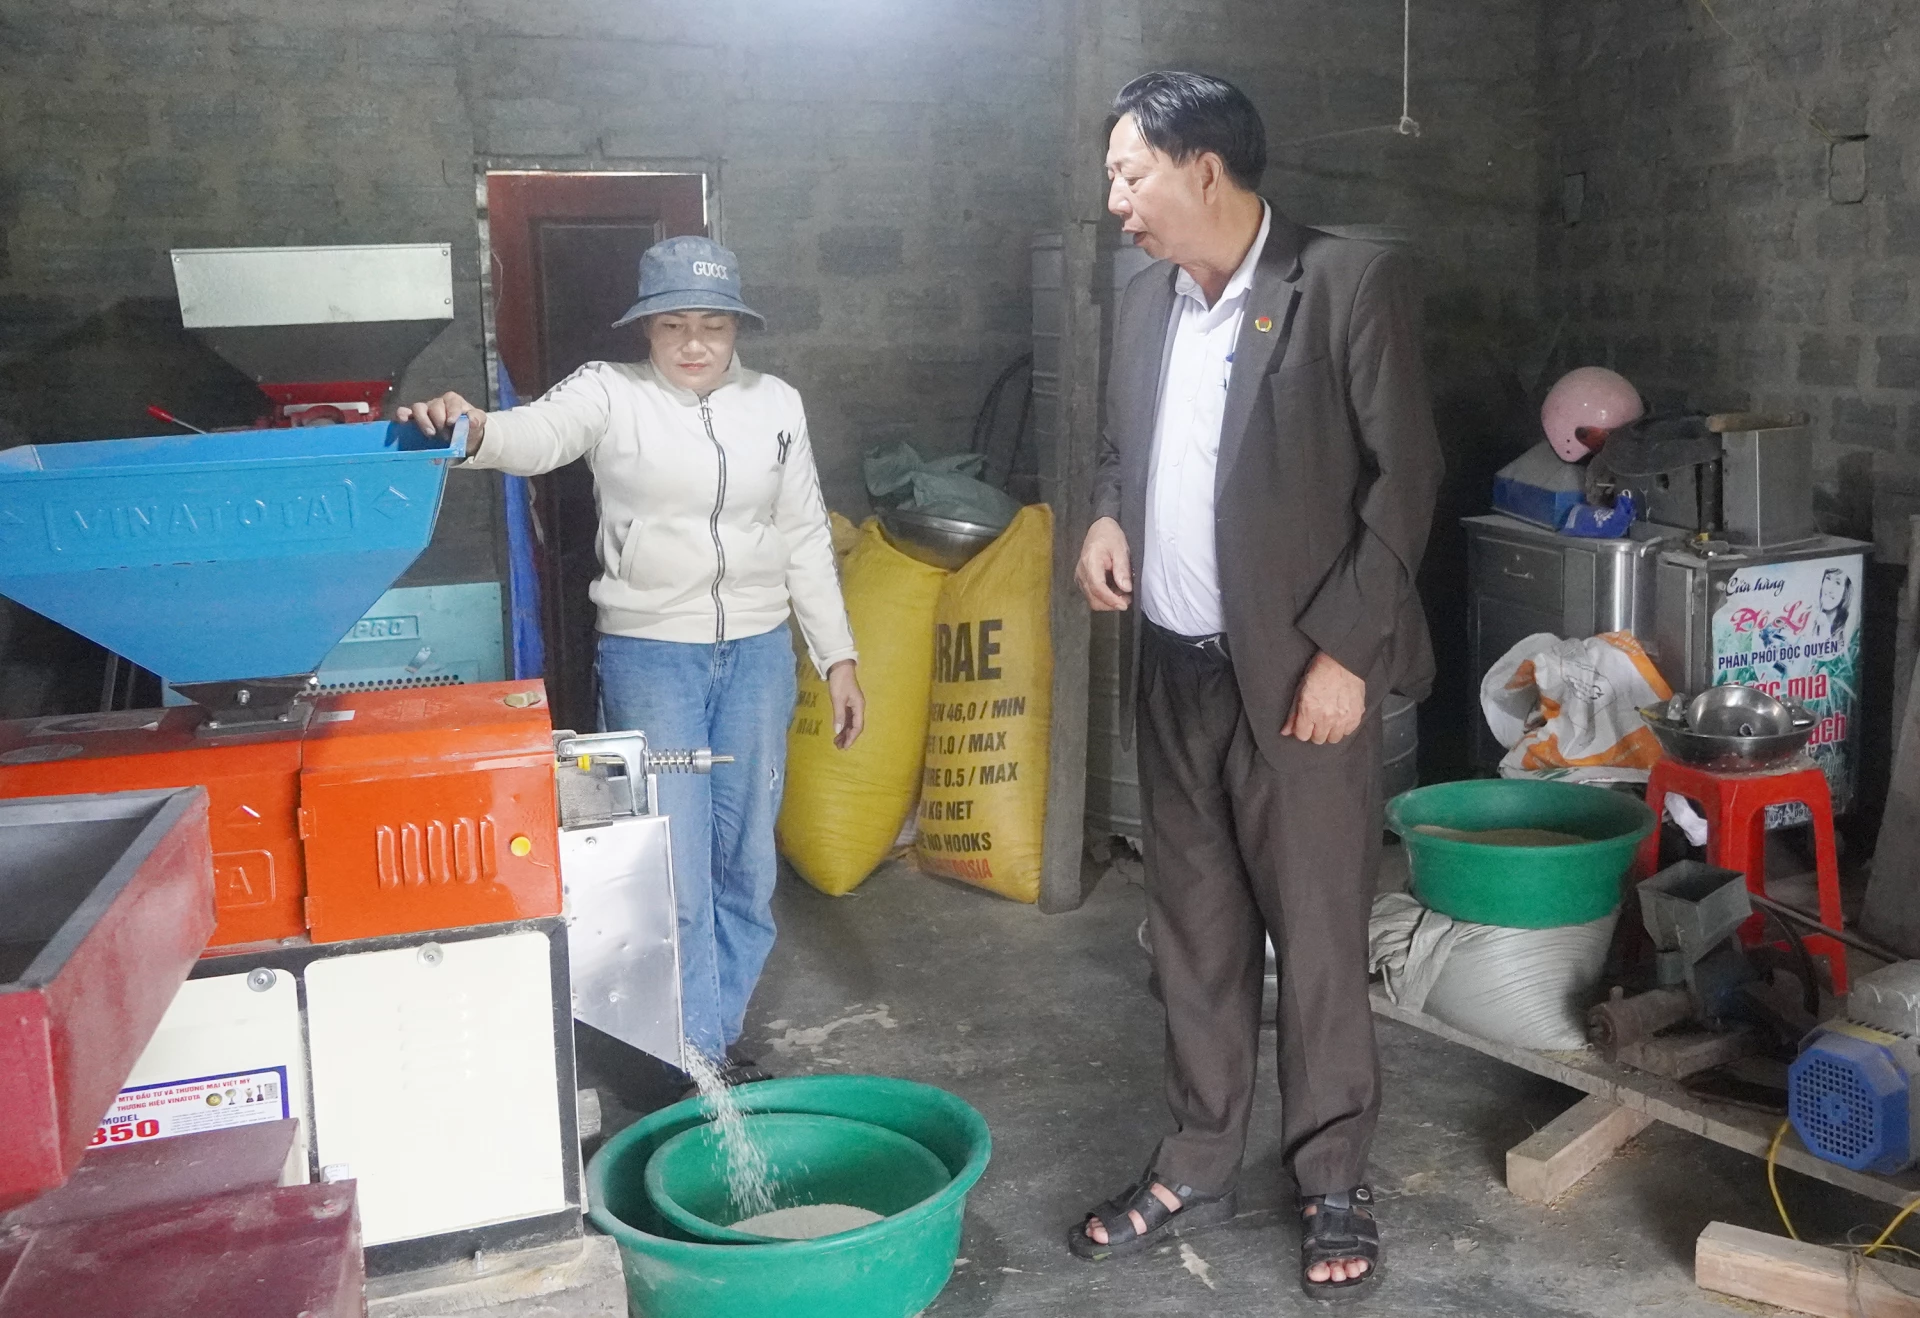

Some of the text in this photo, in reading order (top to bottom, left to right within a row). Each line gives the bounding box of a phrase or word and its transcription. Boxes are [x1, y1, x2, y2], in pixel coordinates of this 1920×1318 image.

[1718, 653, 1748, 669] PHÂN
[1788, 665, 1827, 700] mía
[991, 696, 1026, 718] MIN
[968, 731, 1007, 753] MAX
[944, 768, 965, 788] 0.5
[980, 762, 1018, 785] MAX
[946, 800, 974, 820] NET
[943, 831, 992, 852] HOOKS
[102, 1113, 140, 1126] MODEL
